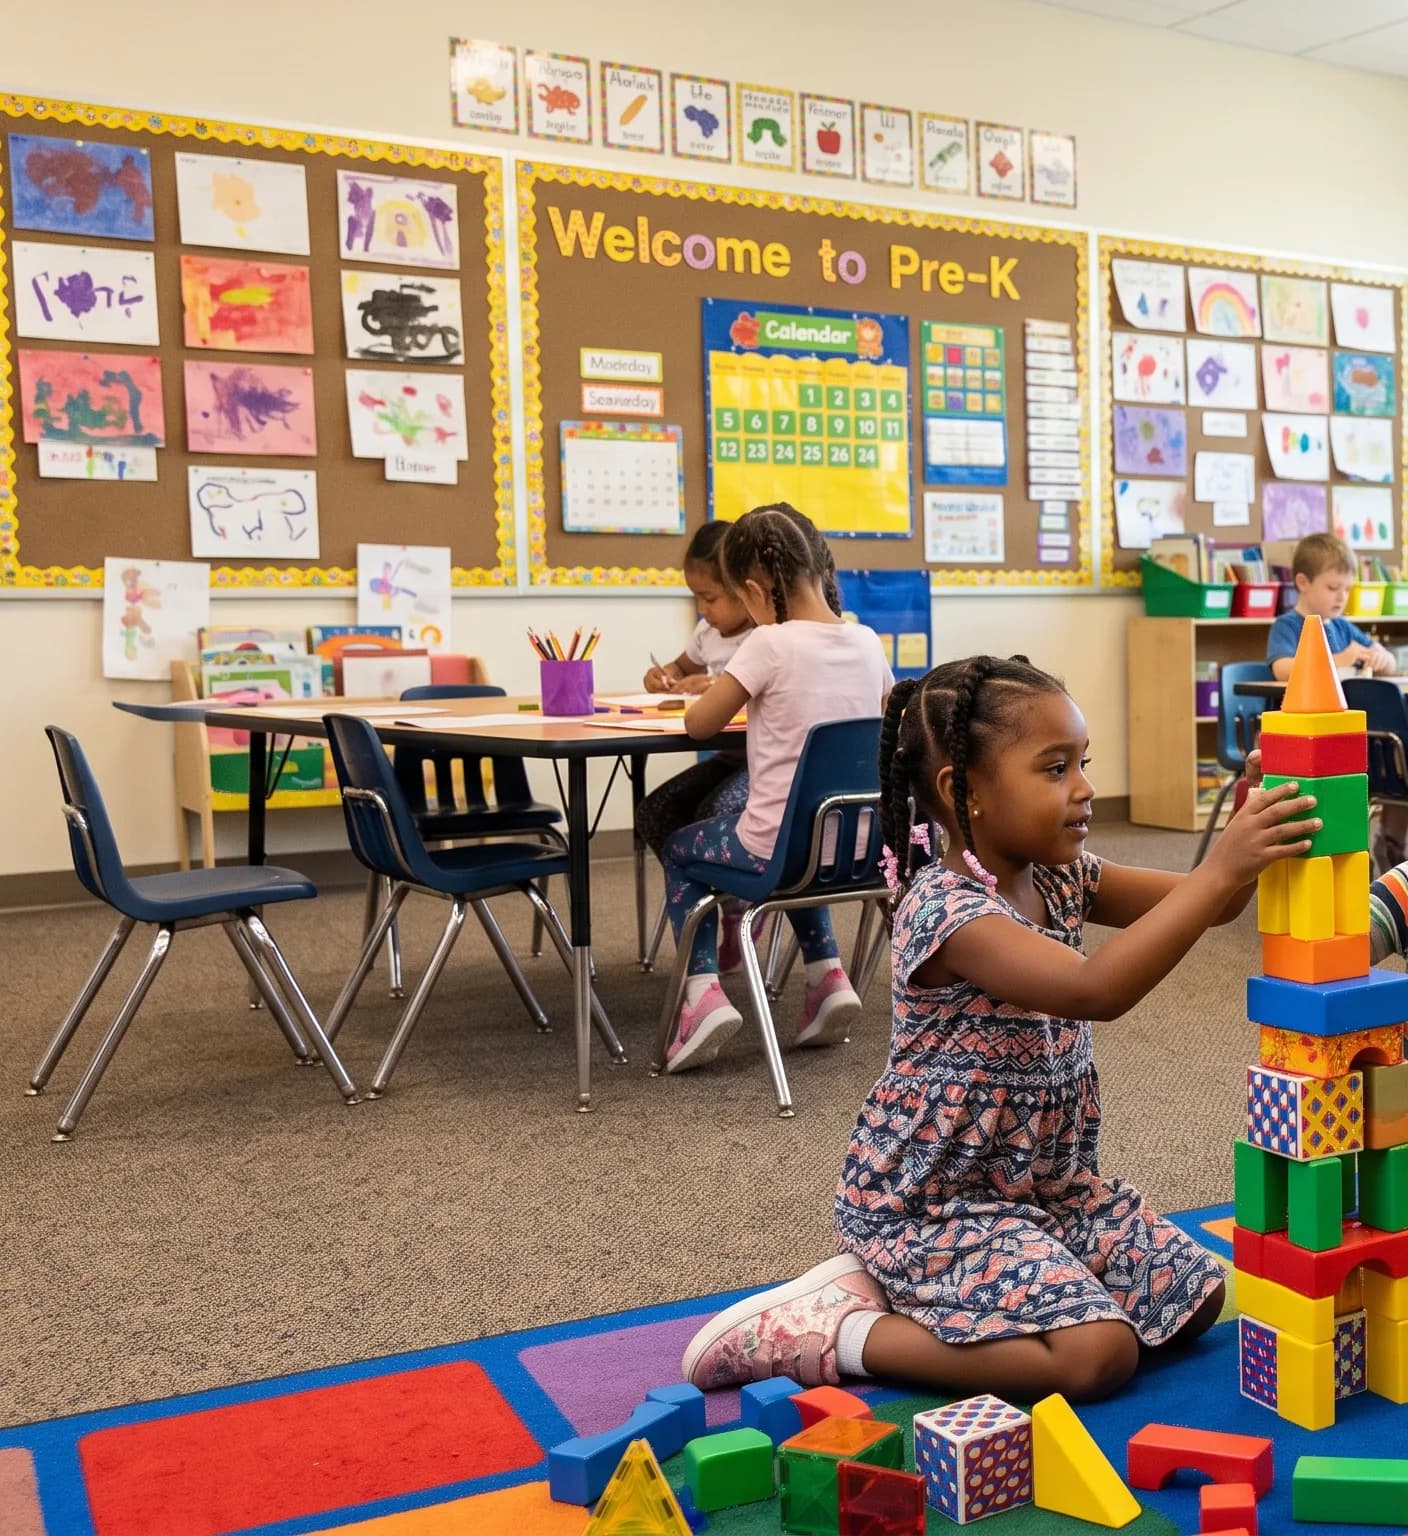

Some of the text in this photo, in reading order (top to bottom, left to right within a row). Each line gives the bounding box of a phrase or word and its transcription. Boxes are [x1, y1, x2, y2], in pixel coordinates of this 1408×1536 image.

[546, 206, 1021, 301] Welcome to Pre-K
[765, 320, 851, 344] Calendar
[807, 388, 897, 407] 1 2 3 4
[723, 412, 899, 436] 5 6 7 8 9 10 11
[747, 443, 767, 458] 23
[775, 445, 794, 459] 24
[803, 446, 821, 461] 25
[830, 447, 849, 462] 26
[858, 449, 875, 463] 24
